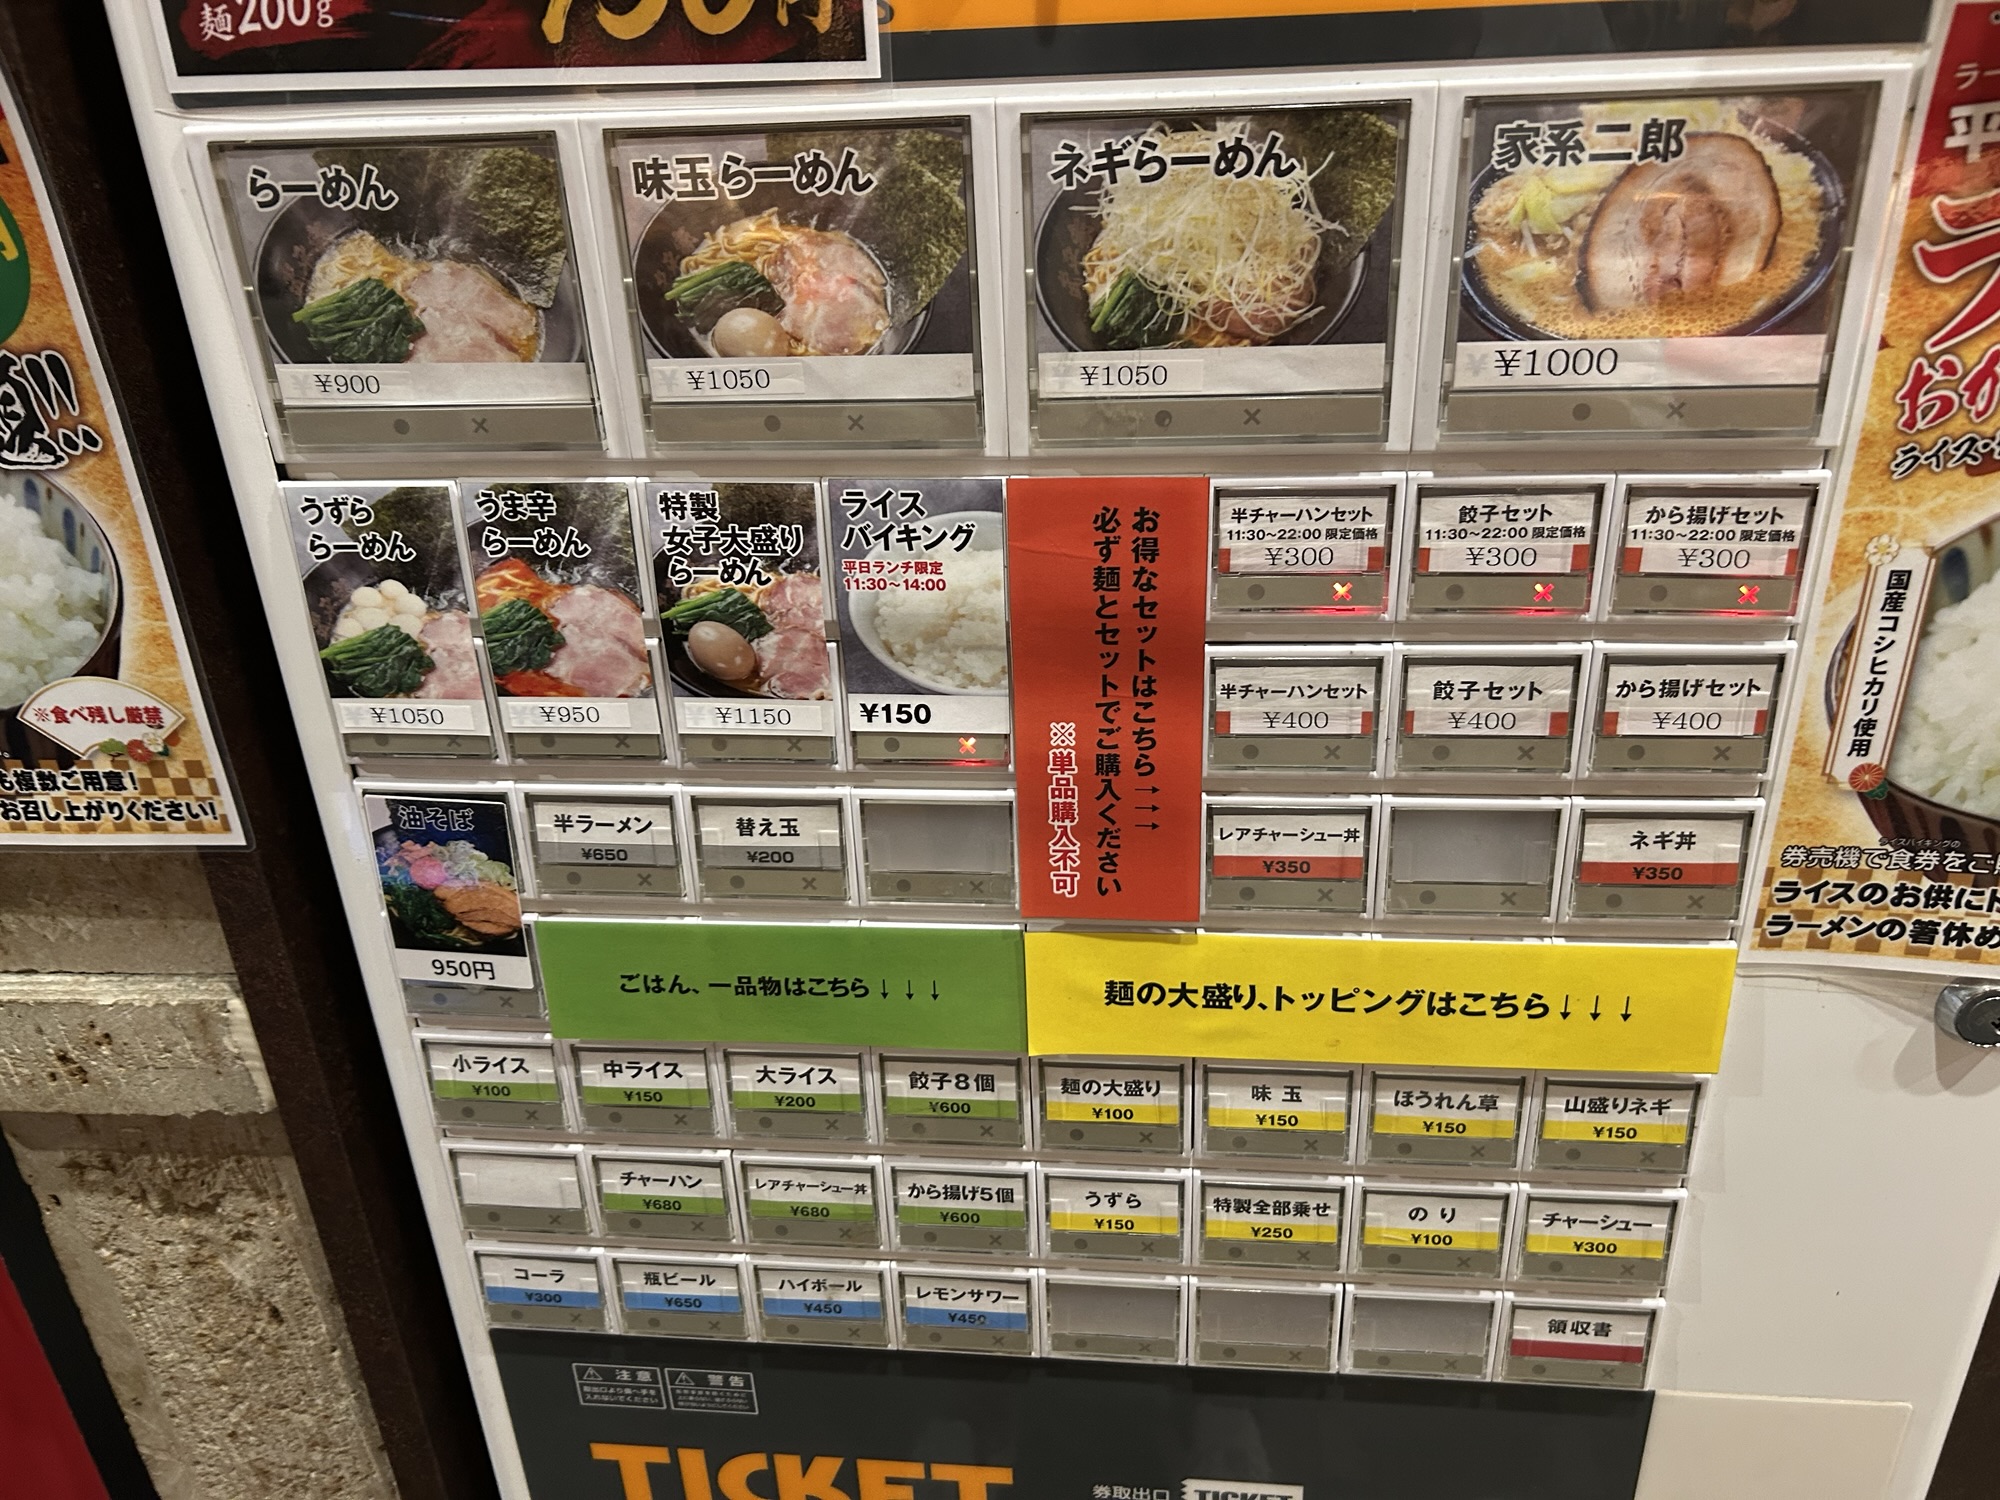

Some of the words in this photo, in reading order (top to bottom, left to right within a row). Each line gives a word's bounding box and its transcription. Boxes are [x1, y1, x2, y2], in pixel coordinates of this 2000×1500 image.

[1491, 117, 1688, 169] 家系二郎
[1048, 130, 1300, 190] ネギらーめん
[631, 147, 877, 200] 味玉らーめん
[247, 165, 399, 210] らーめん
[1494, 347, 1619, 377] ¥1000
[314, 374, 381, 394] ¥900
[687, 369, 771, 391] ¥1050
[1080, 365, 1169, 386] ¥1050
[300, 495, 375, 527] うずら
[475, 491, 558, 522] うま辛
[658, 491, 721, 522] 特製
[840, 489, 928, 520] ライス
[1458, 504, 1553, 524] 餃子セット
[1231, 506, 1373, 524] 半チャーハンセット
[1645, 505, 1785, 525] から揚げセット
[482, 526, 592, 559] らーめん
[661, 524, 806, 557] 女子大盛り
[841, 522, 977, 553] バイキング
[1325, 527, 1378, 540] 限定価格
[1531, 526, 1586, 539] 限定価格
[1739, 529, 1796, 542] 限定価格
[307, 531, 417, 562] らーめん
[1466, 546, 1538, 567] ¥300
[1264, 547, 1334, 567] ¥300
[1677, 548, 1751, 569] ¥300
[667, 557, 773, 588] らーめん
[842, 560, 944, 576] 平日ランチ限定
[1131, 505, 1161, 778] お得なセットはこちら
[1846, 568, 1912, 757] 国産コシヒカリ使用
[1220, 683, 1368, 700] 半チャーハンセット
[1432, 680, 1544, 701] 餃子セット
[1614, 678, 1762, 699] から揚げセット
[1092, 505, 1122, 896] 必ず麺とセットでご購入ください
[33, 706, 165, 726] ※食べ残し厳禁
[369, 706, 444, 726] ¥1050
[540, 705, 601, 724] ¥950
[715, 706, 792, 727] ¥1150
[859, 703, 932, 725] ¥150
[1262, 711, 1329, 729] ¥400
[1448, 711, 1516, 730] ¥400
[1652, 711, 1722, 731] ¥400
[398, 804, 475, 831] 油そば
[1047, 721, 1081, 898] ※単品購入不可
[554, 813, 654, 835] 半ラーメン
[736, 817, 801, 838] 替え玉
[1218, 826, 1361, 844] レアチャーシュー丼
[1629, 830, 1698, 851] ネギ丼
[581, 847, 629, 862] ¥650
[746, 850, 795, 864] ¥200
[1262, 860, 1312, 874] ¥350
[1631, 866, 1684, 881] ¥350
[431, 958, 497, 982] 950円
[619, 974, 870, 998] ごはん、一品物はこちら
[1103, 979, 1552, 1021] 麺の大盛り、トッピングはこちら
[453, 1055, 530, 1075] 小ライス
[603, 1060, 684, 1079] 中ライス
[756, 1065, 838, 1085] 大ライス
[471, 1084, 511, 1097] ¥100
[908, 1071, 996, 1093] 餃子8個
[1060, 1078, 1162, 1097] 麺の大盛り
[624, 1090, 663, 1103] ¥150
[774, 1094, 816, 1108] ¥200
[1394, 1089, 1500, 1112] ほうれん草
[1564, 1095, 1673, 1117] 山盛りネギ
[928, 1101, 971, 1114] ¥600
[1092, 1107, 1134, 1121] ¥100
[1255, 1113, 1299, 1127] ¥150
[1422, 1120, 1467, 1135] ¥150
[1592, 1125, 1638, 1140] ¥150
[620, 1171, 703, 1188] チャーハン
[755, 1179, 868, 1195] レアチャーシュー丼
[907, 1183, 1015, 1203] から揚げ5個
[1085, 1191, 1143, 1210] うずら
[642, 1198, 682, 1212] ¥680
[790, 1205, 830, 1218] ¥680
[1213, 1196, 1331, 1218] 特製全部乗せ
[939, 1211, 981, 1224] ¥600
[1094, 1218, 1135, 1231] ¥150
[1542, 1211, 1653, 1232] チャーシュー
[1250, 1226, 1294, 1240] ¥250
[1410, 1232, 1453, 1247] ¥100
[1573, 1240, 1618, 1254] ¥300
[514, 1268, 566, 1284] コーラ
[643, 1271, 716, 1287] 瓶ビール
[779, 1278, 863, 1293] ハイボール
[524, 1291, 562, 1304] ¥300
[664, 1296, 702, 1309] ¥650
[916, 1286, 1020, 1304] レモンサワー
[804, 1302, 842, 1315] ¥450
[1547, 1318, 1613, 1338] 領収書
[590, 1443, 1013, 1500] TICKET
